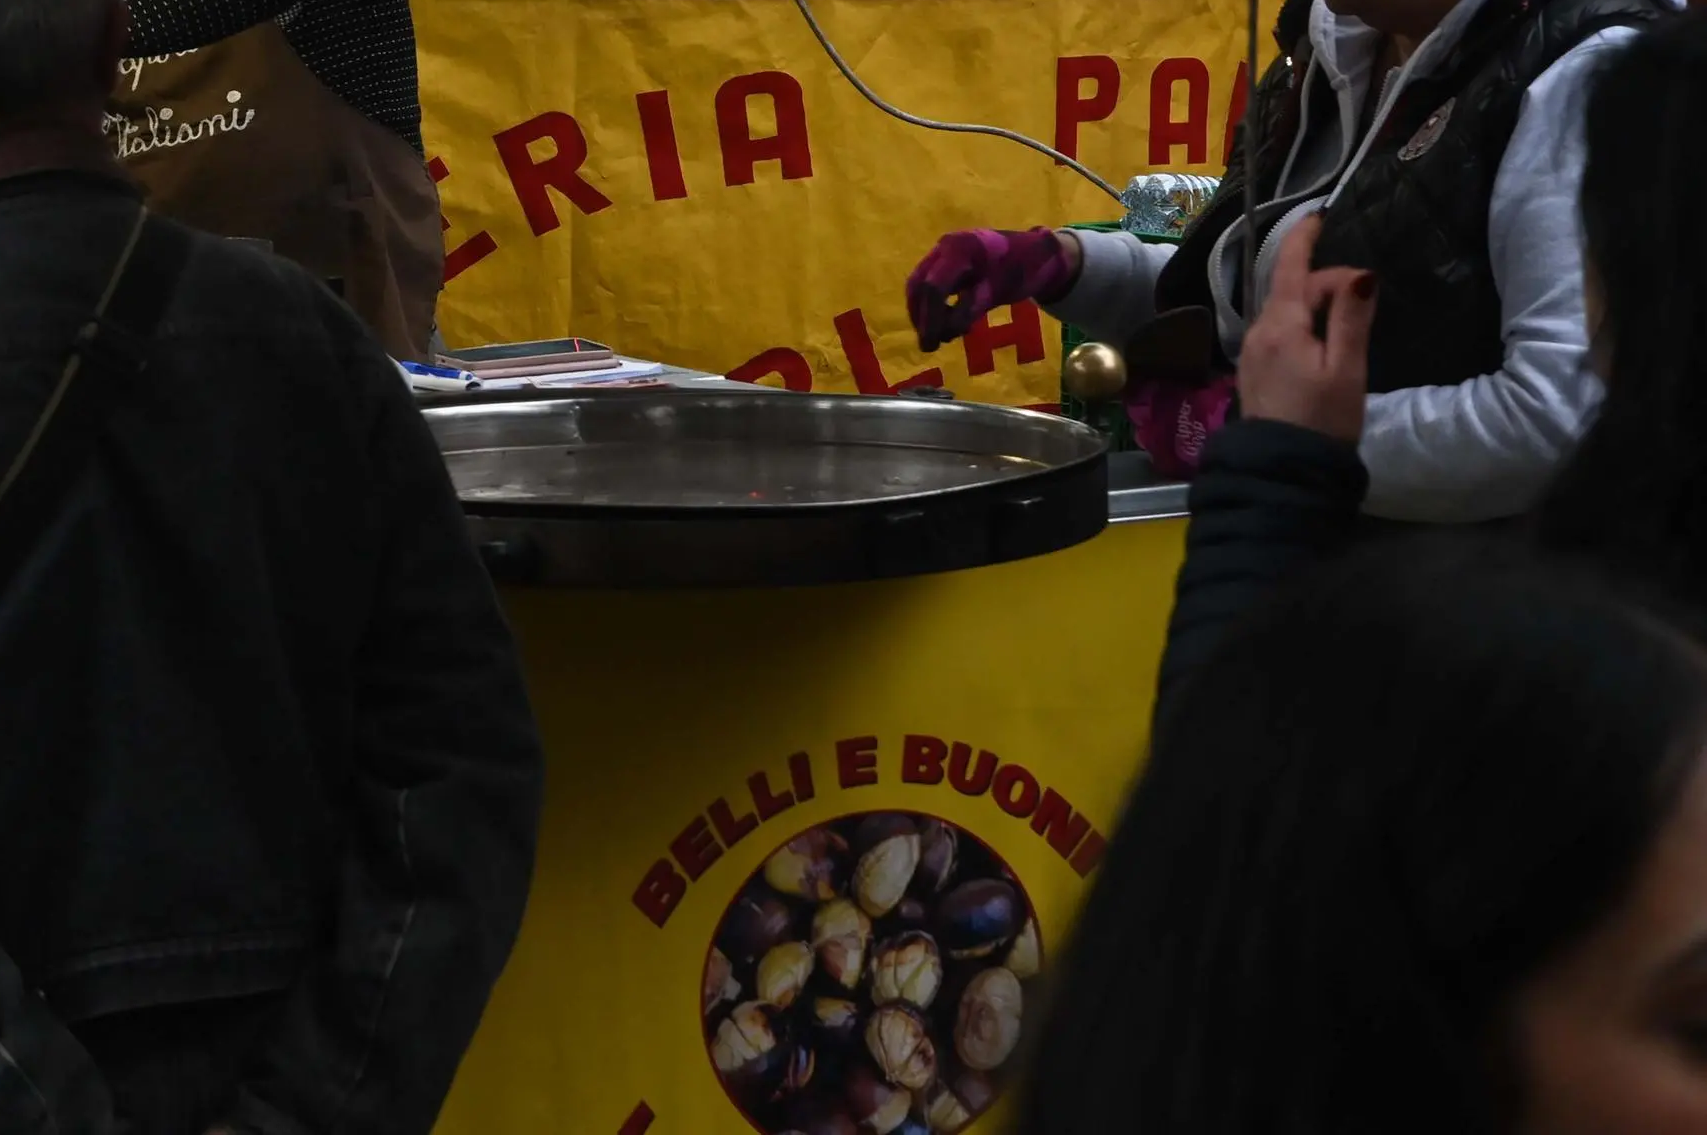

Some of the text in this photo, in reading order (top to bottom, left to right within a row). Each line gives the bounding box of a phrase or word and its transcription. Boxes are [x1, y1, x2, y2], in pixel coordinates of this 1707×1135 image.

[102, 90, 256, 160] Italiani
[1055, 55, 1250, 166] PA
[632, 734, 1108, 929] BELLI E BUONI
